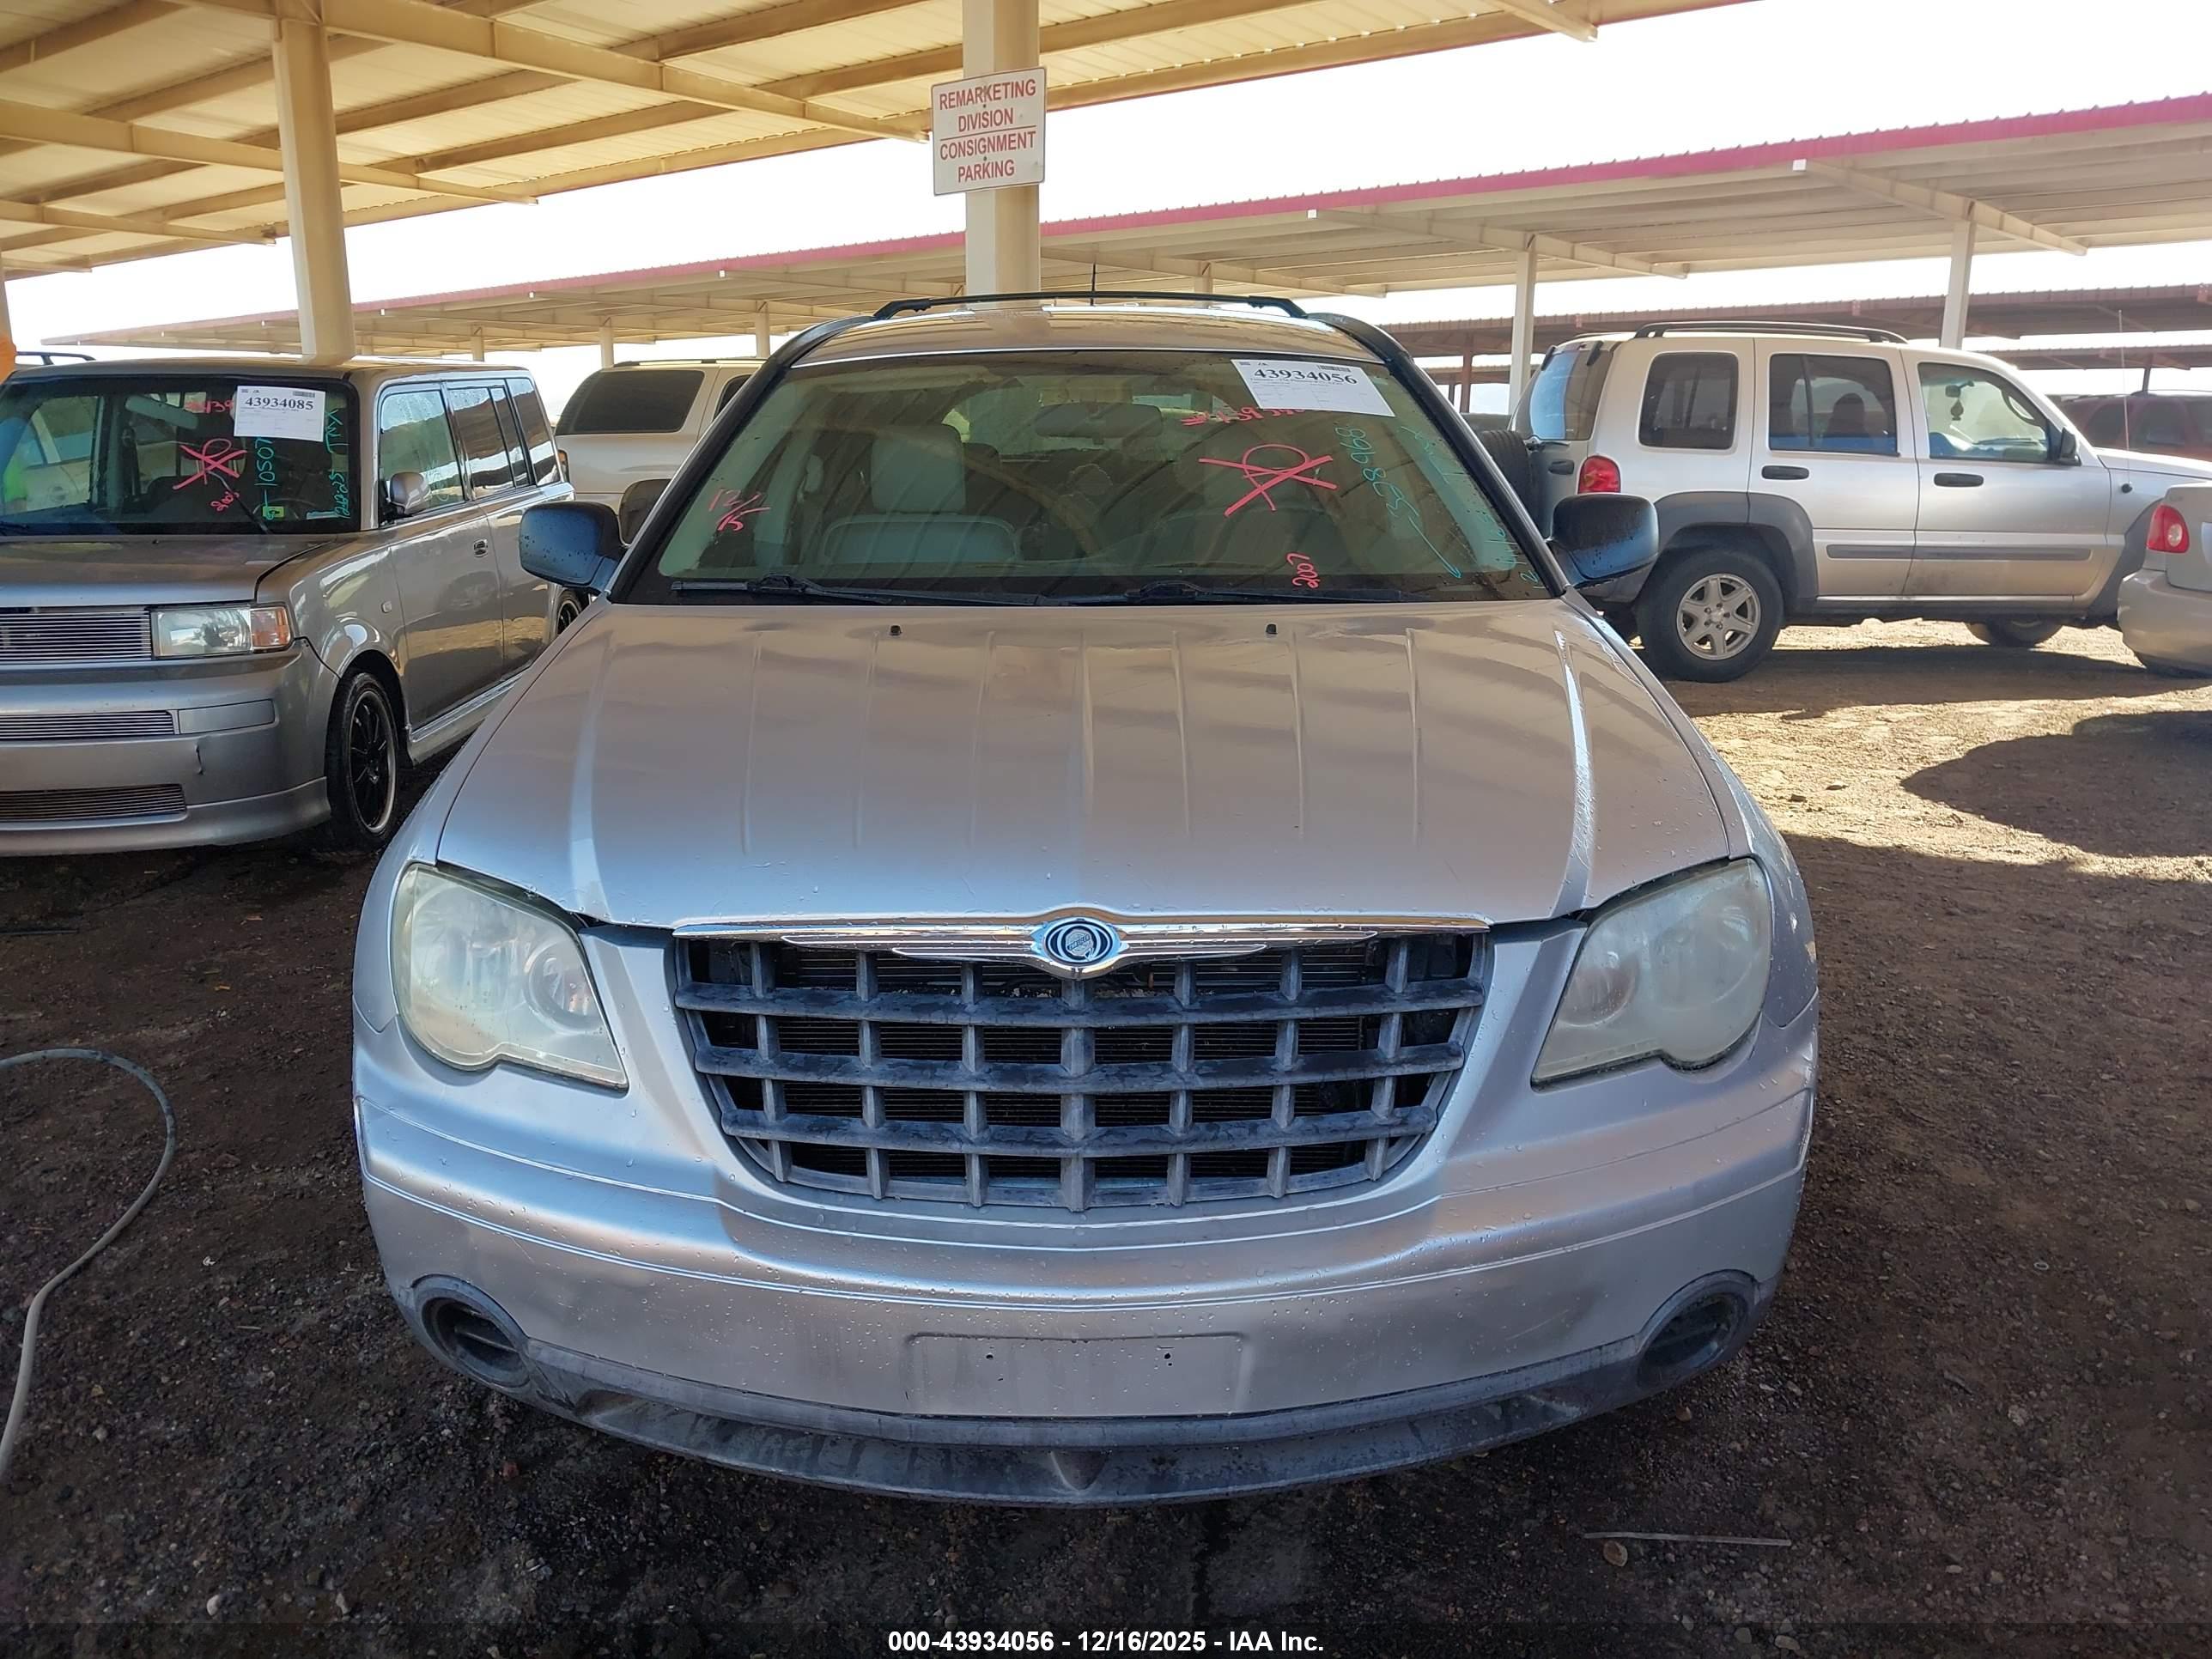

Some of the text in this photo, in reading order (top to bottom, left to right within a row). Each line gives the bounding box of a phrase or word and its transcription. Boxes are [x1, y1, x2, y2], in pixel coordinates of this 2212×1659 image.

[939, 79, 1036, 110] REMARKETING
[958, 107, 1014, 132] DIVISION
[939, 131, 1036, 161] CONSIGNMENT
[958, 159, 1014, 183] PARKING
[1254, 368, 1358, 385] 43934056
[245, 397, 314, 410] 43934085
